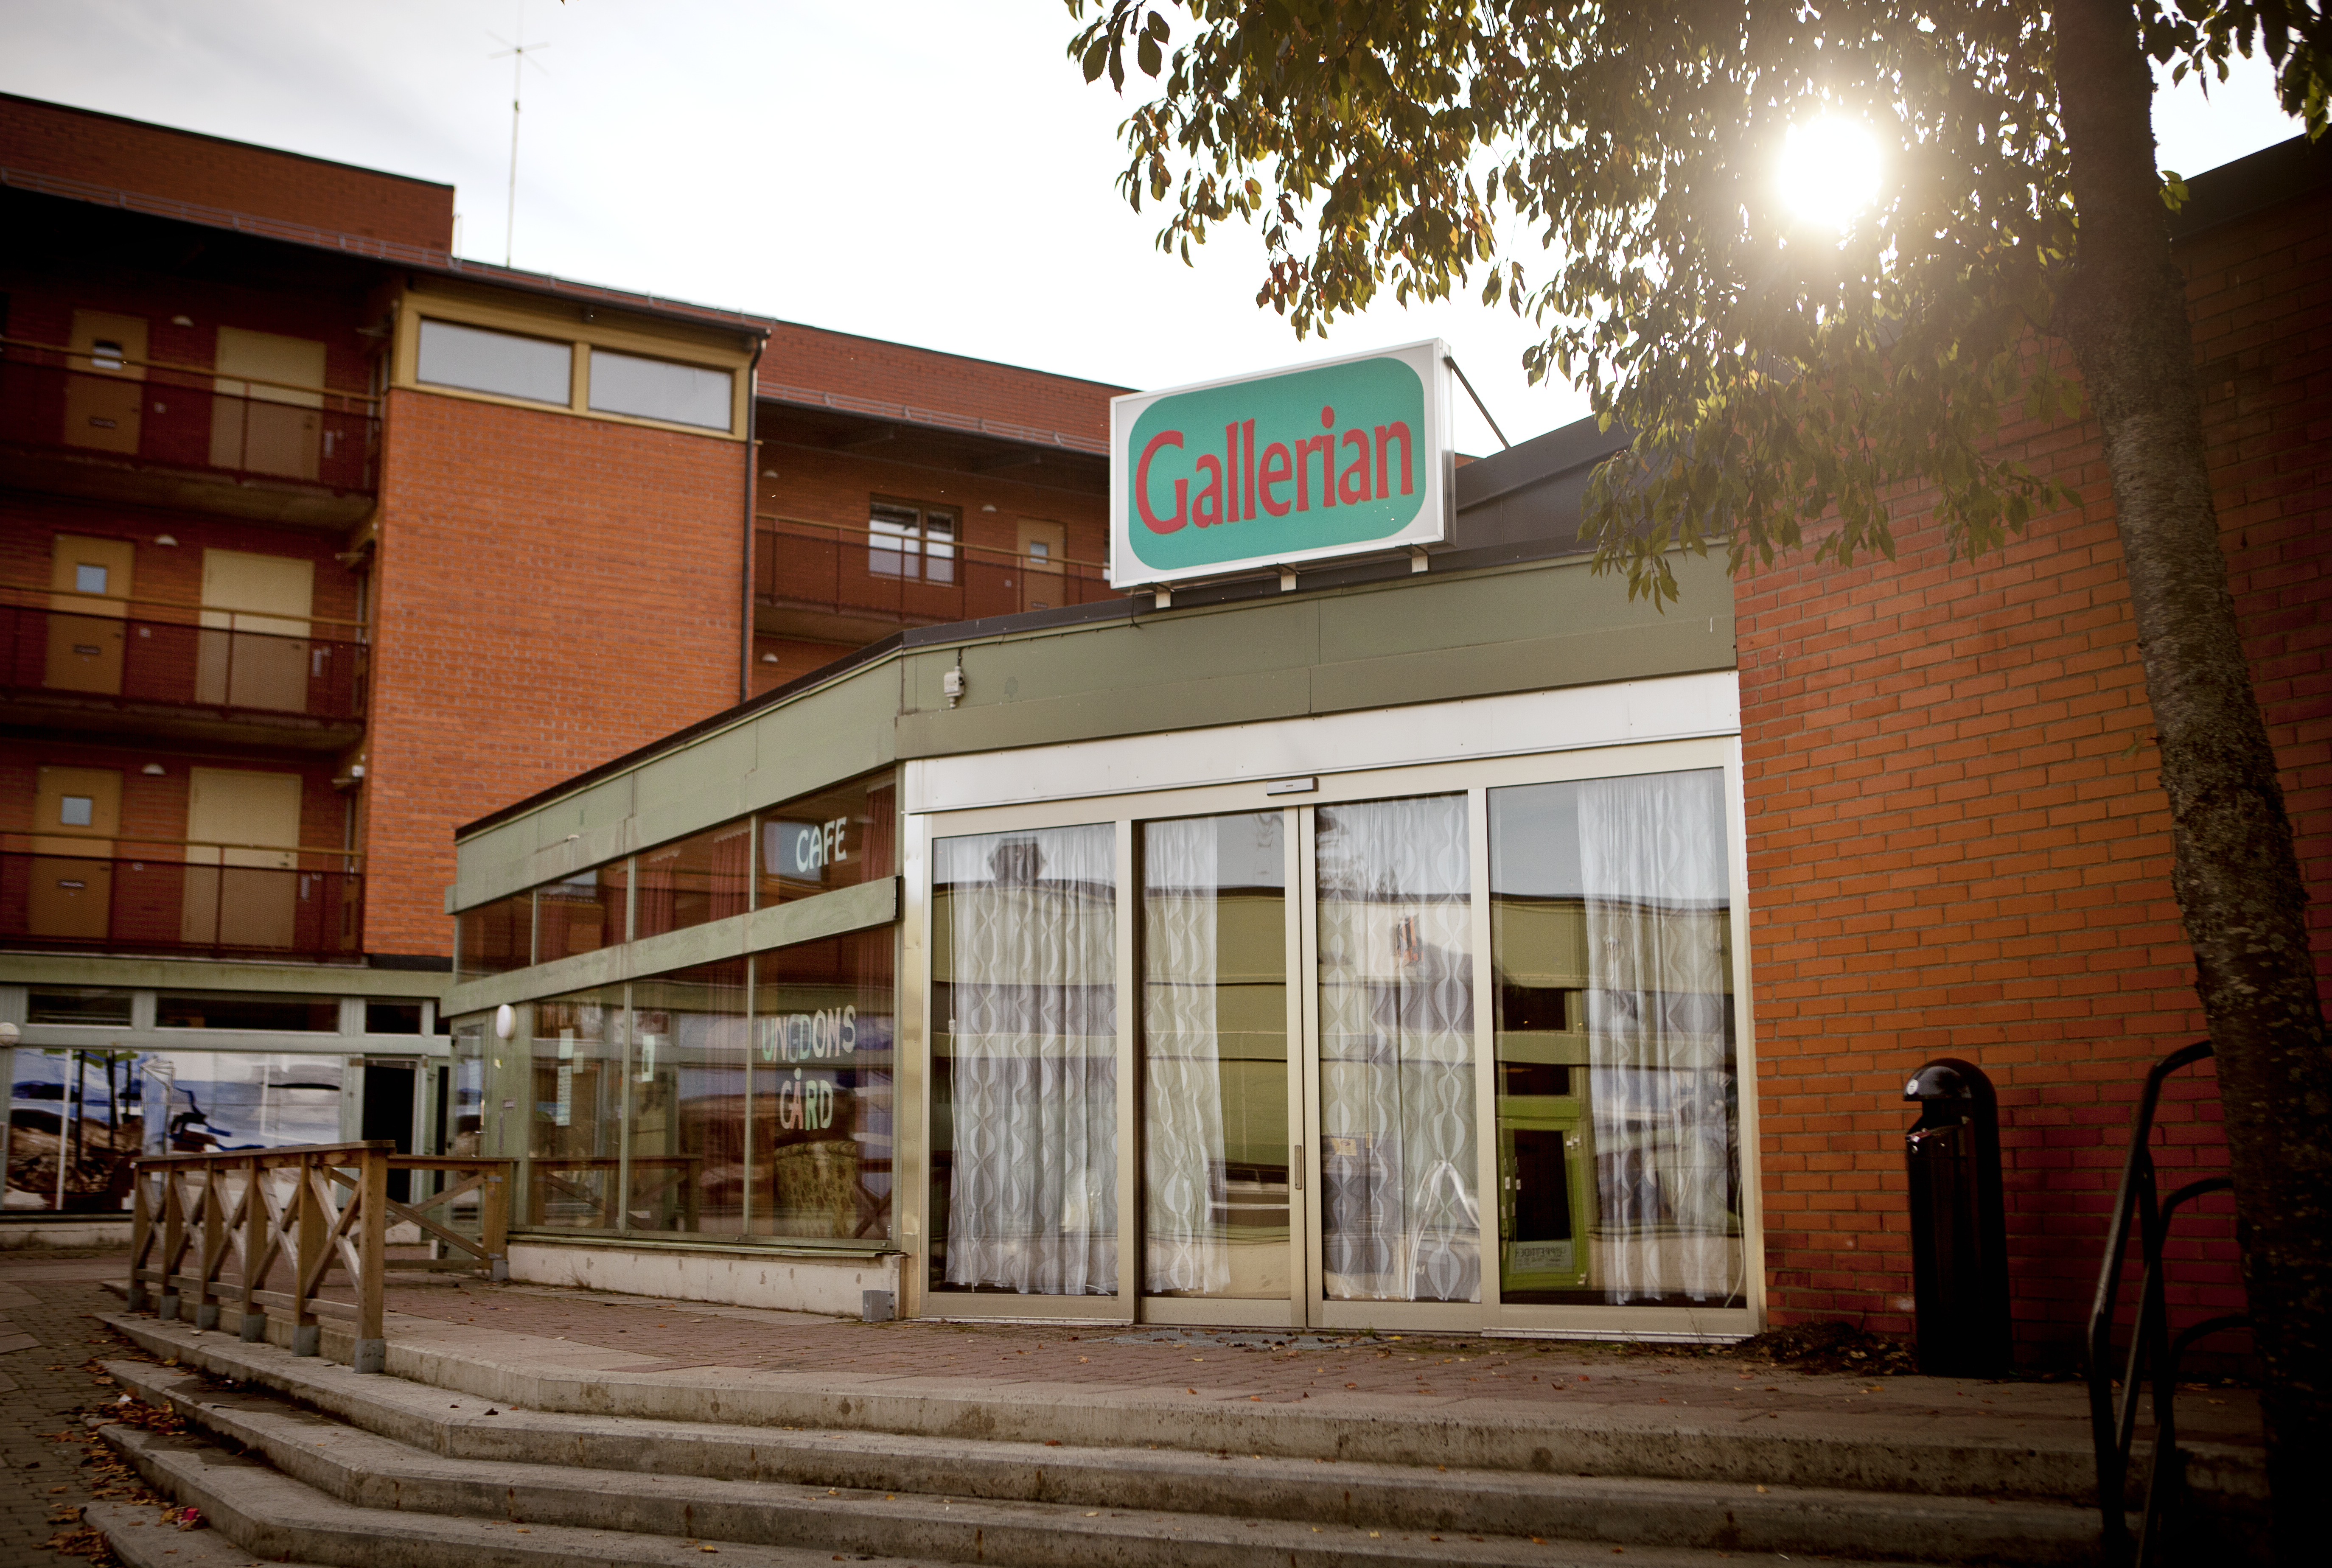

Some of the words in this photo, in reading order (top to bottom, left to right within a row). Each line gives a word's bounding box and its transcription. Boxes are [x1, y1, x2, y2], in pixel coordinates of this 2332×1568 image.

[1135, 406, 1414, 535] Gallerian
[796, 817, 847, 873] CAFE
[762, 1005, 856, 1063] UNGDOMS
[780, 1067, 833, 1131] GÅRD
